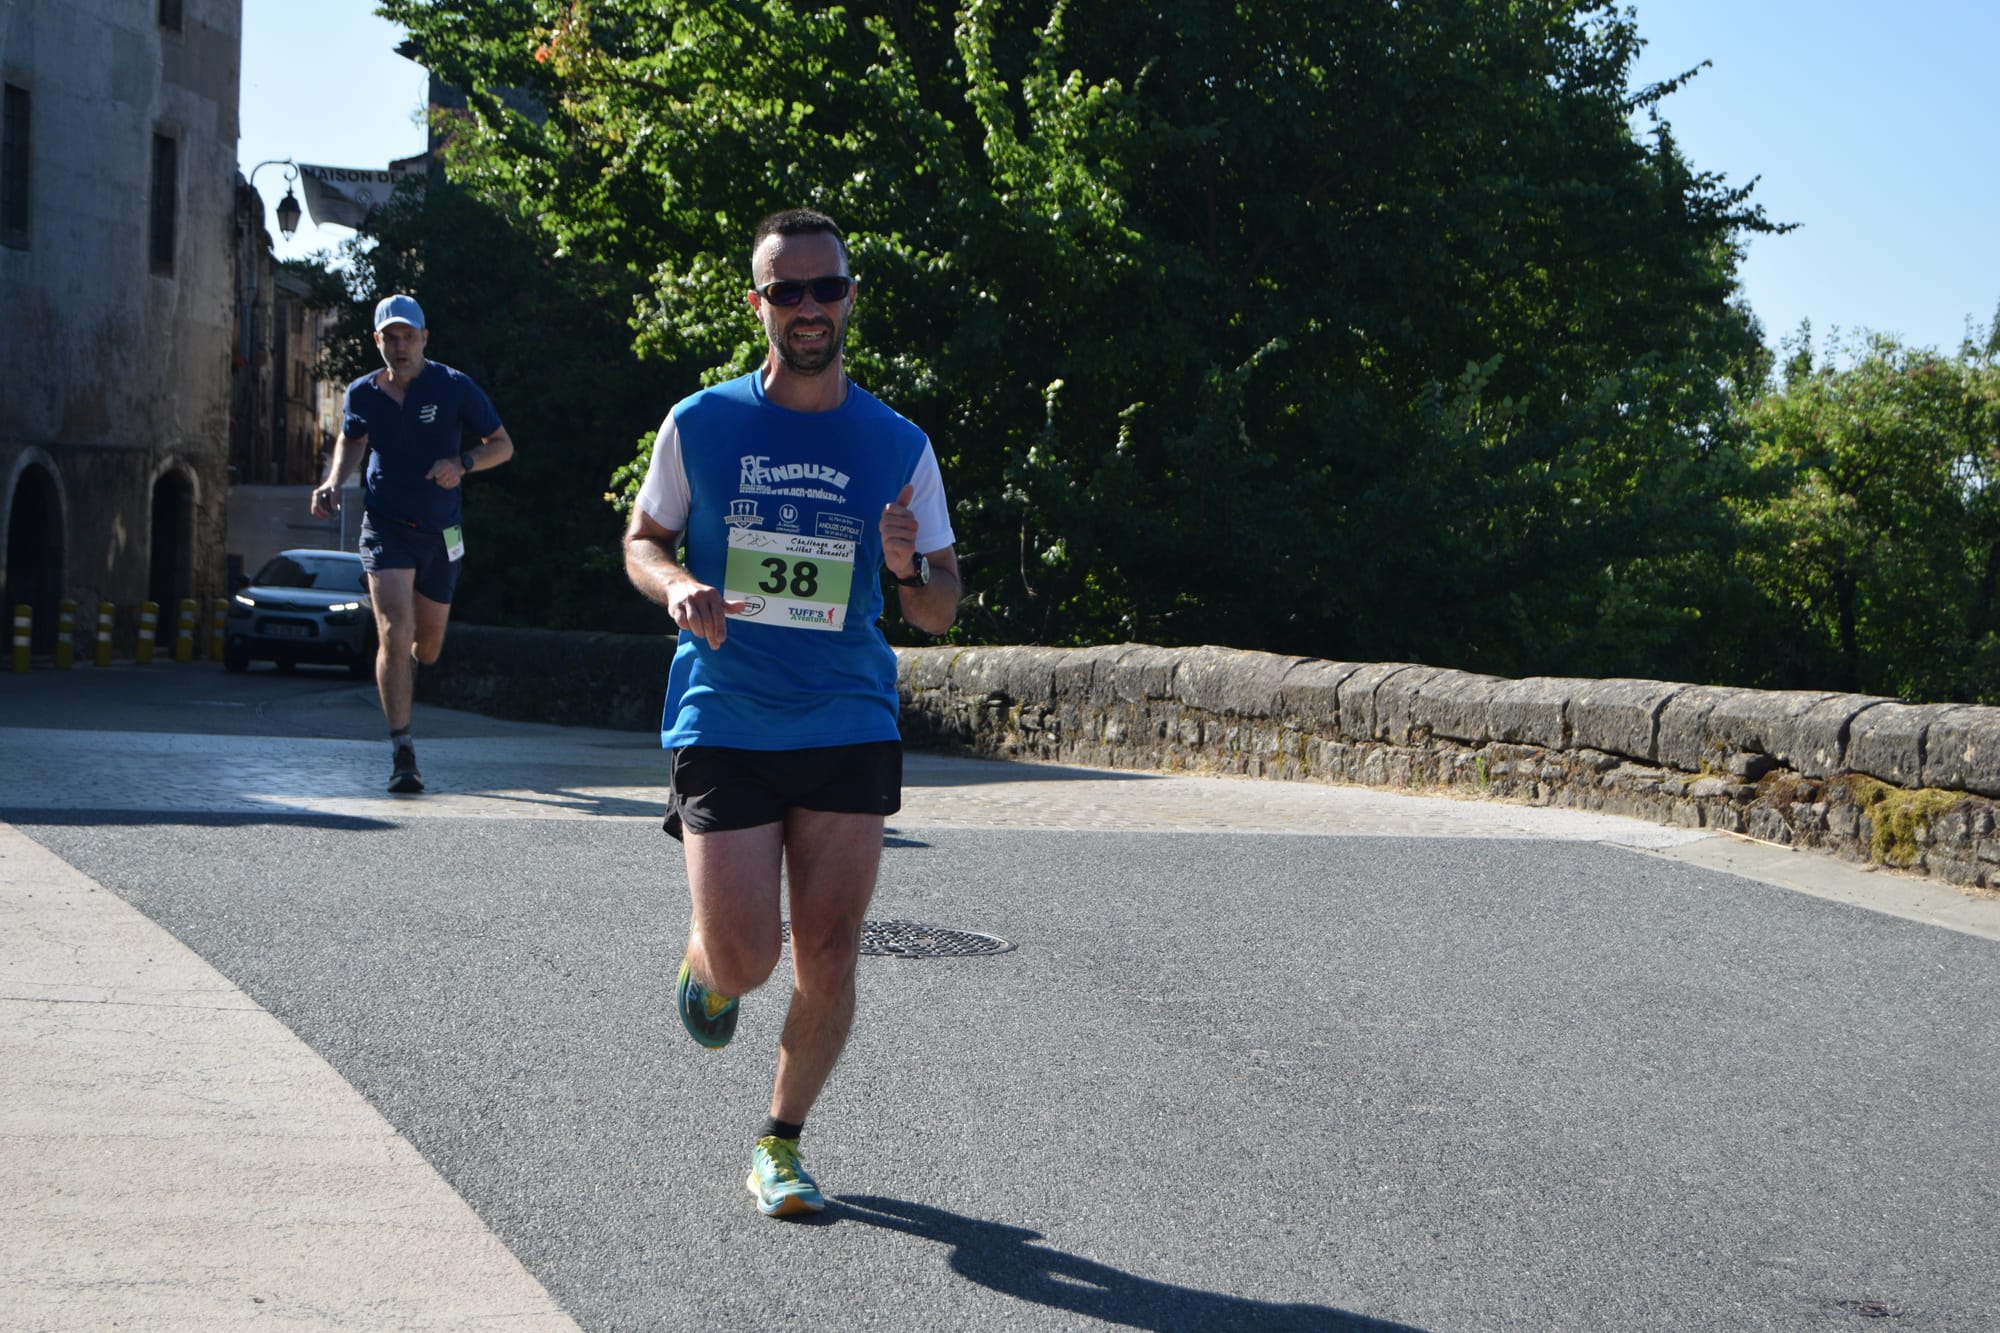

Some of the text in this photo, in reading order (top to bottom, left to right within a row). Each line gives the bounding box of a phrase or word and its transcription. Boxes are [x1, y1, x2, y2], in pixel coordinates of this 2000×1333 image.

[790, 537, 846, 550] Challenge des
[758, 557, 819, 598] 38
[788, 607, 824, 618] TUFF'S
